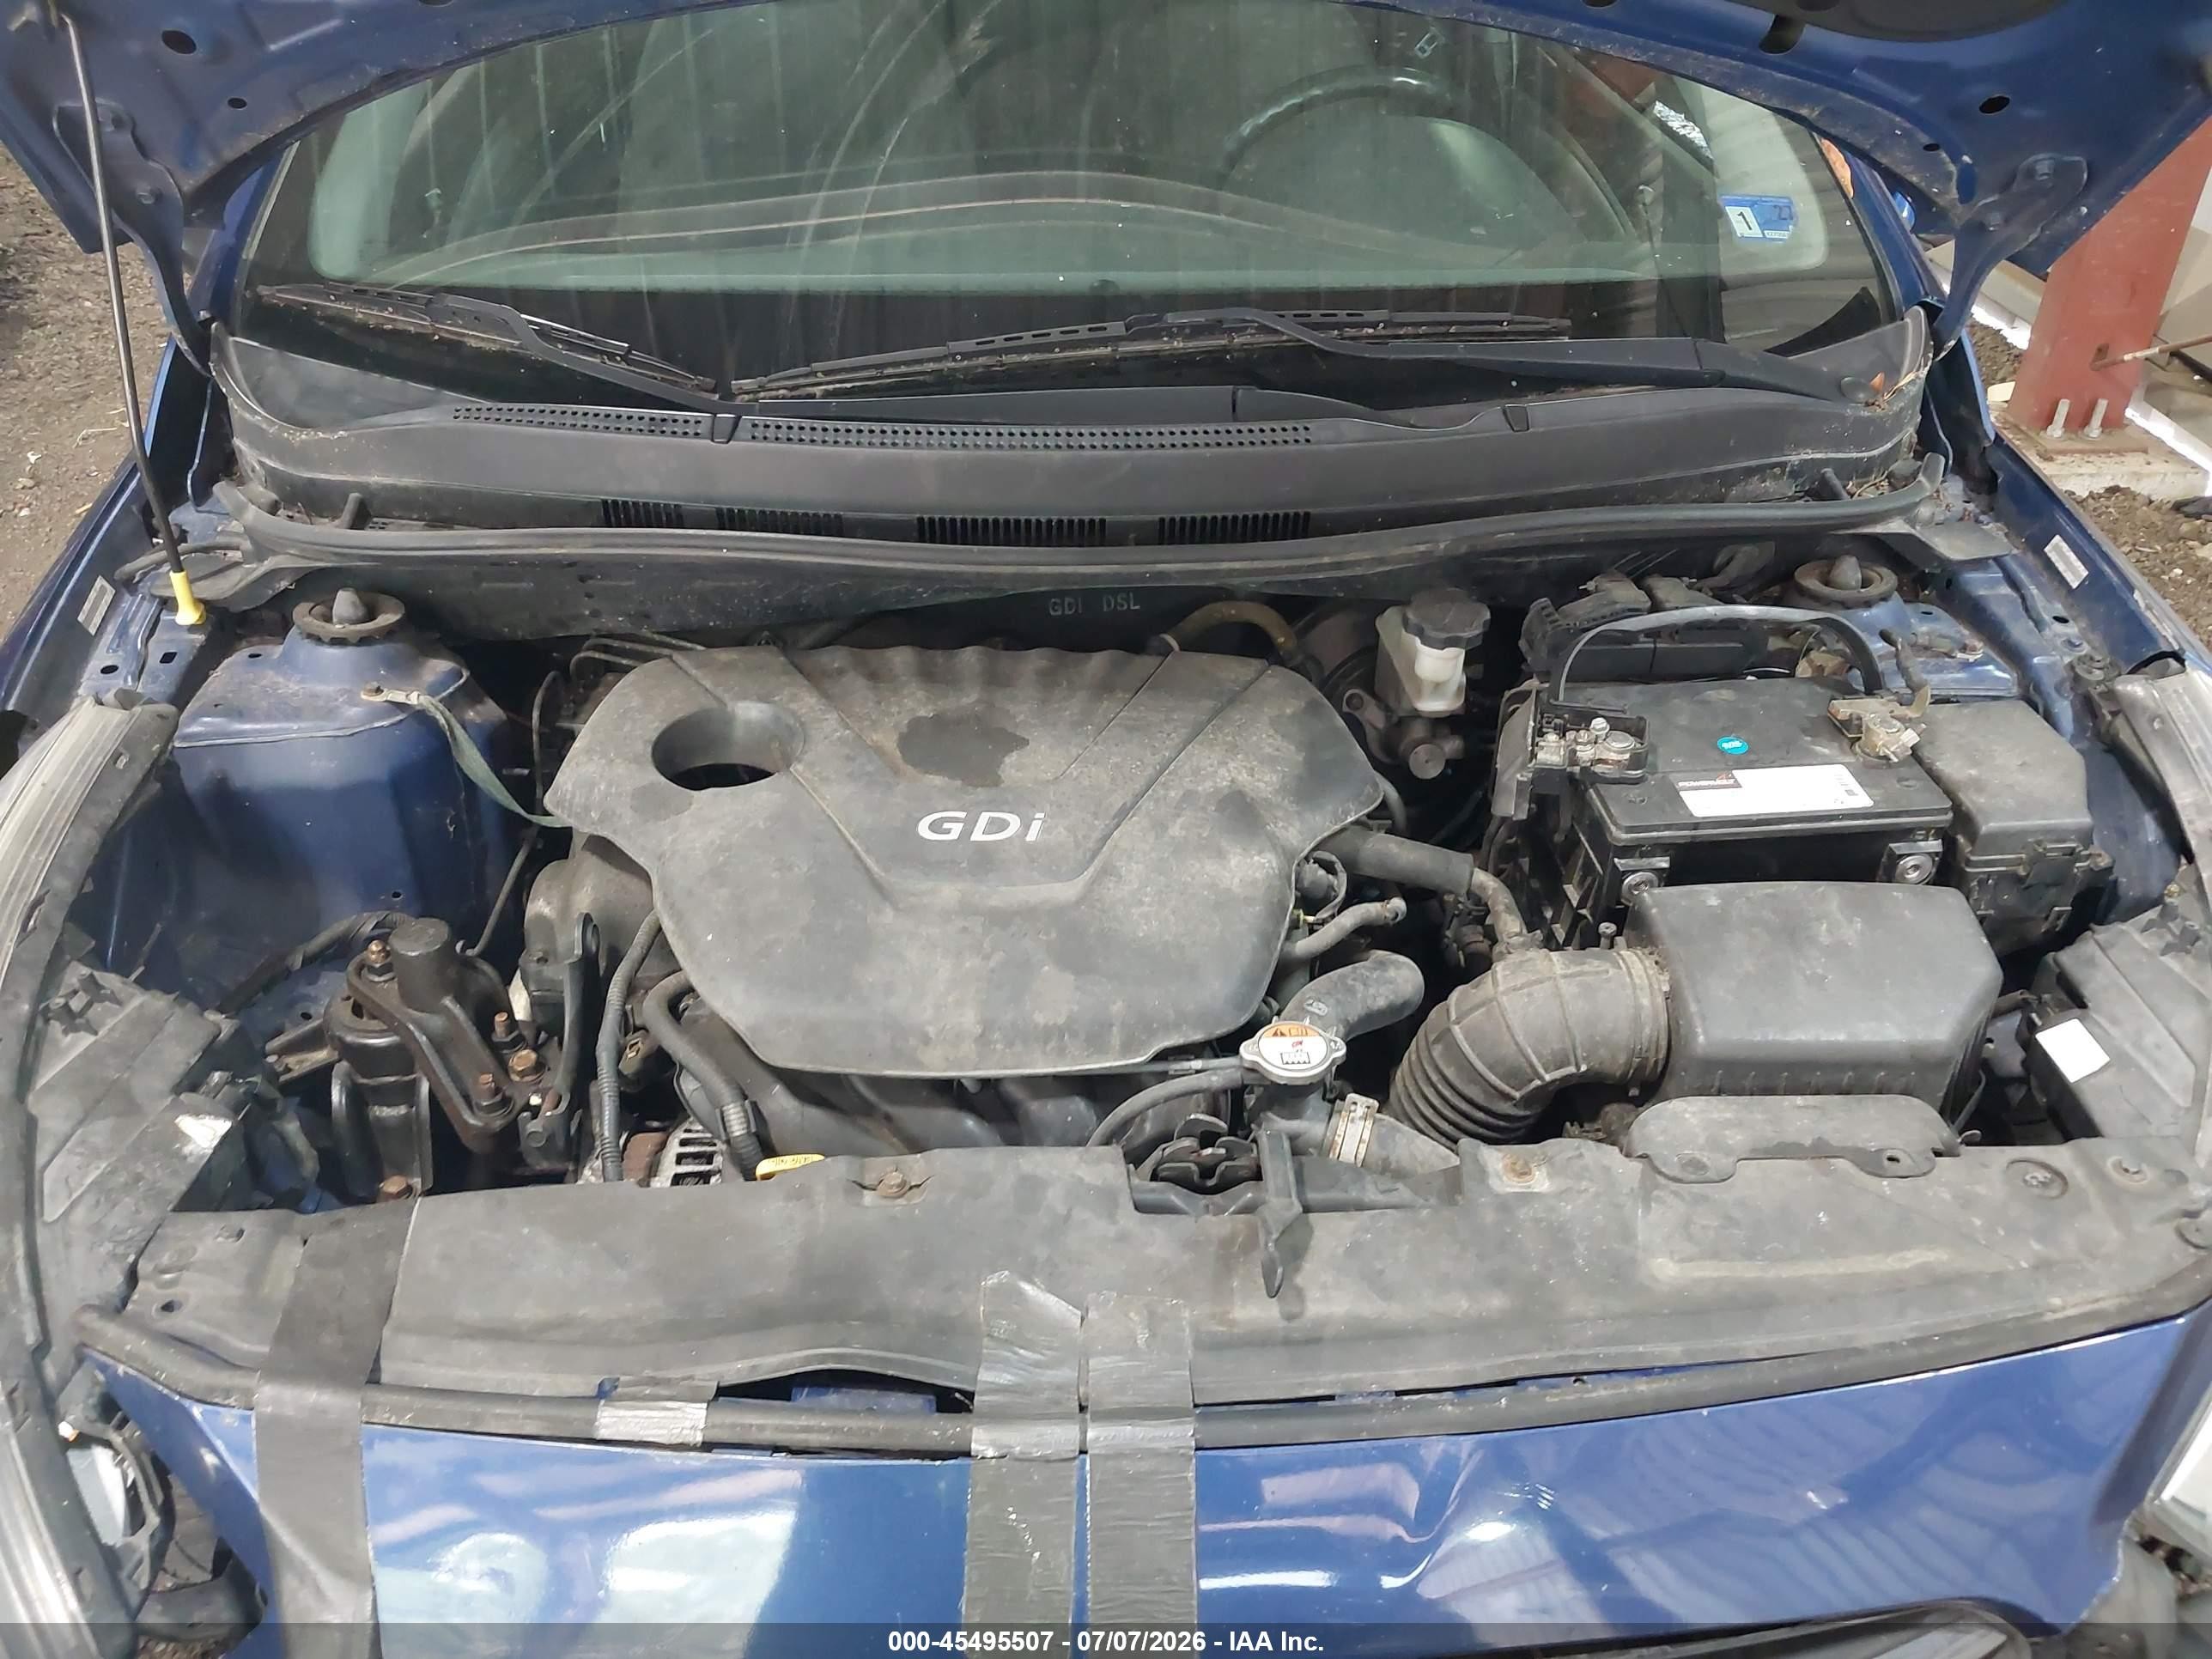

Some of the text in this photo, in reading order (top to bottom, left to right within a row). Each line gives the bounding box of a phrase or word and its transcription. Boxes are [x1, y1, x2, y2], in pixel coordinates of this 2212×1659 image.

[1737, 211, 1753, 231] 1
[1048, 592, 1141, 616] GDI DSL
[917, 810, 1046, 842] GDi
